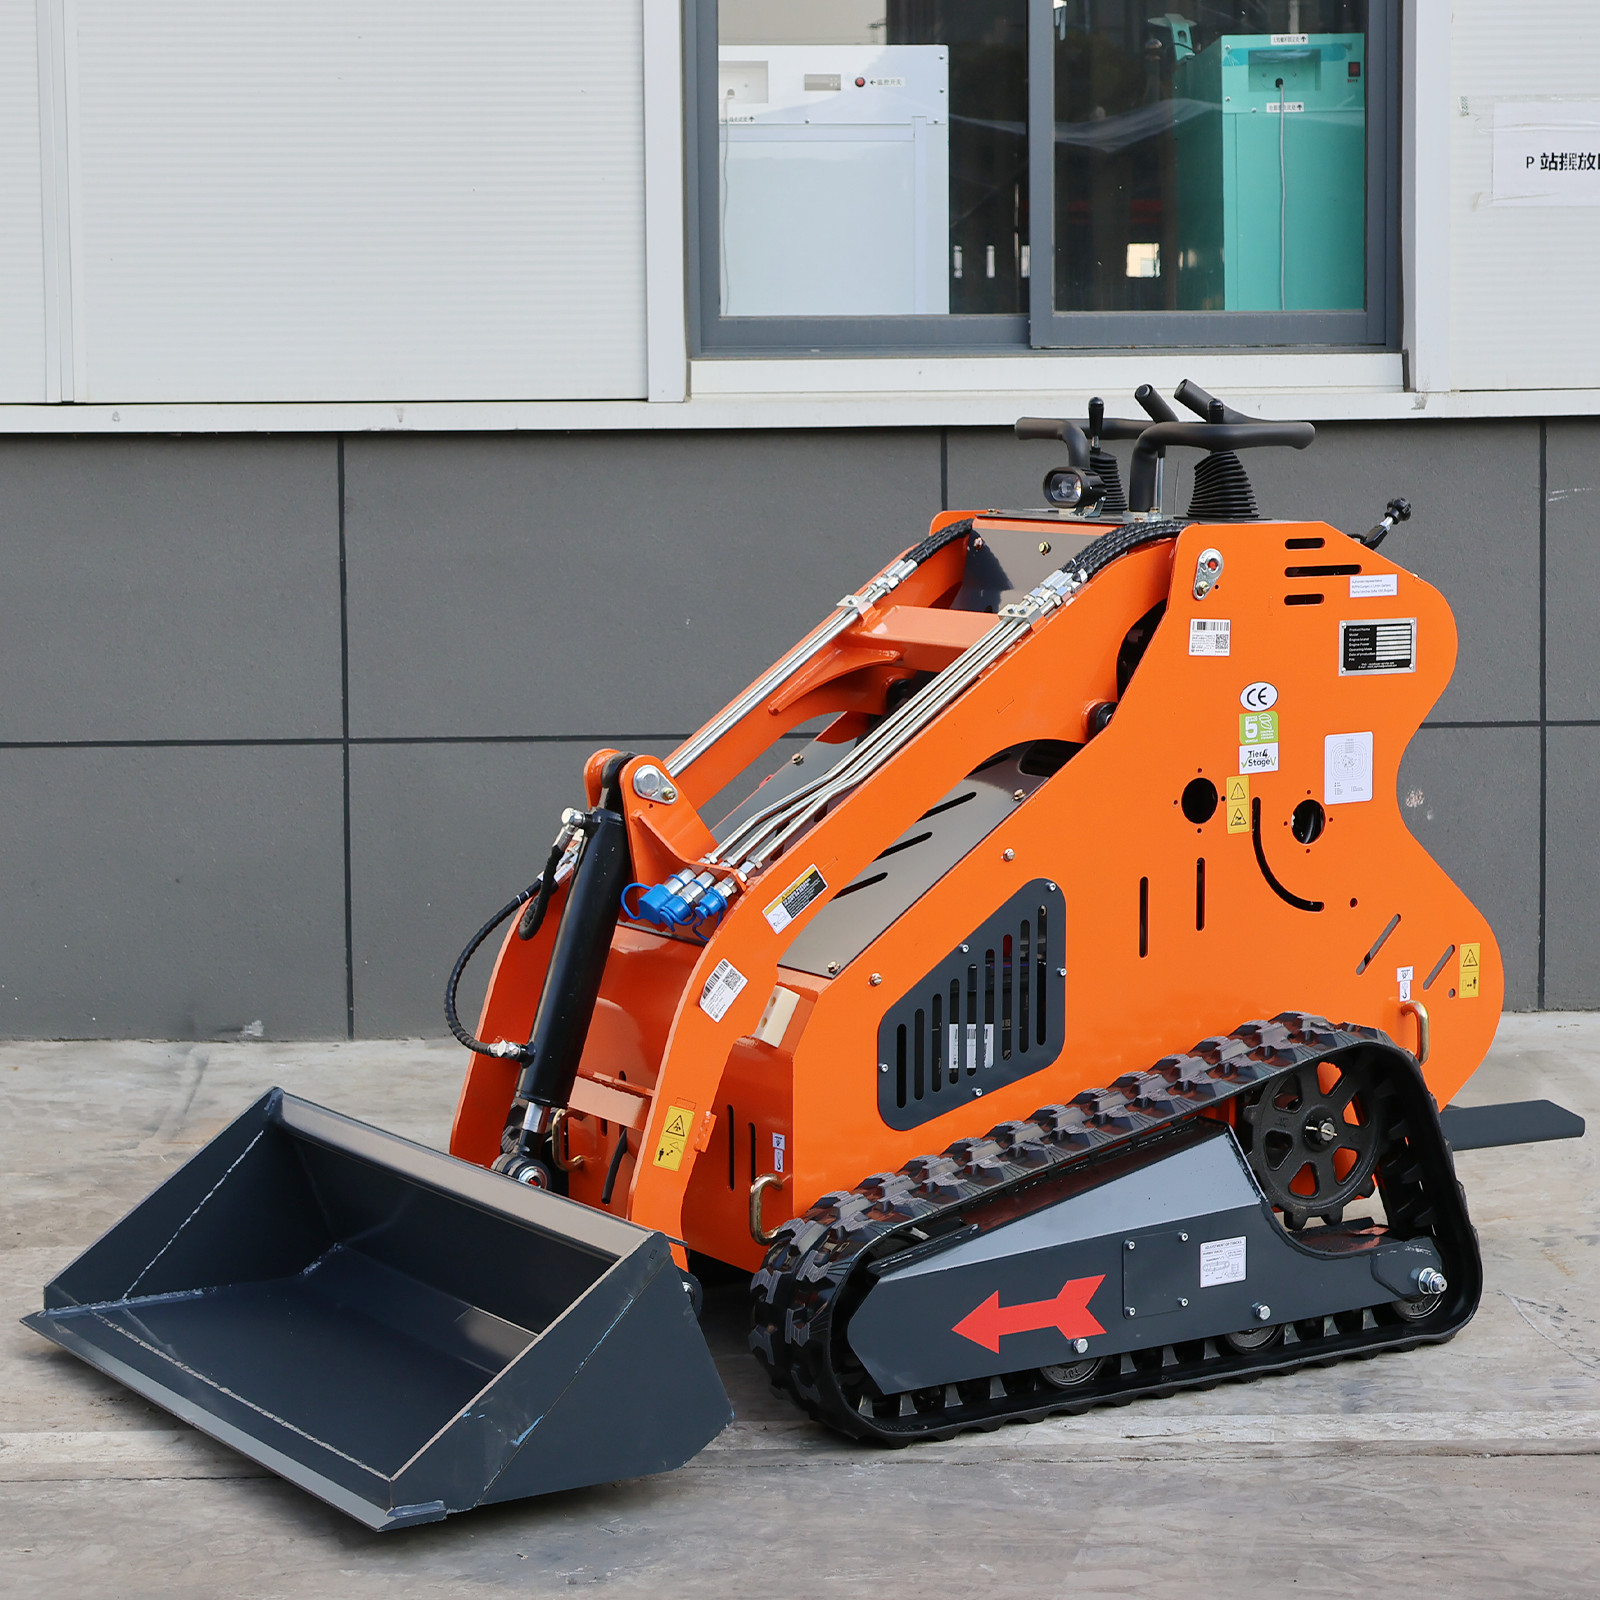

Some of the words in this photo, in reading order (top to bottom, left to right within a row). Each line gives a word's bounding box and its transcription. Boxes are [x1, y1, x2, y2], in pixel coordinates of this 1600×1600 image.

[1526, 156, 1535, 169] P
[1247, 687, 1267, 706] CE
[1246, 716, 1258, 738] 5
